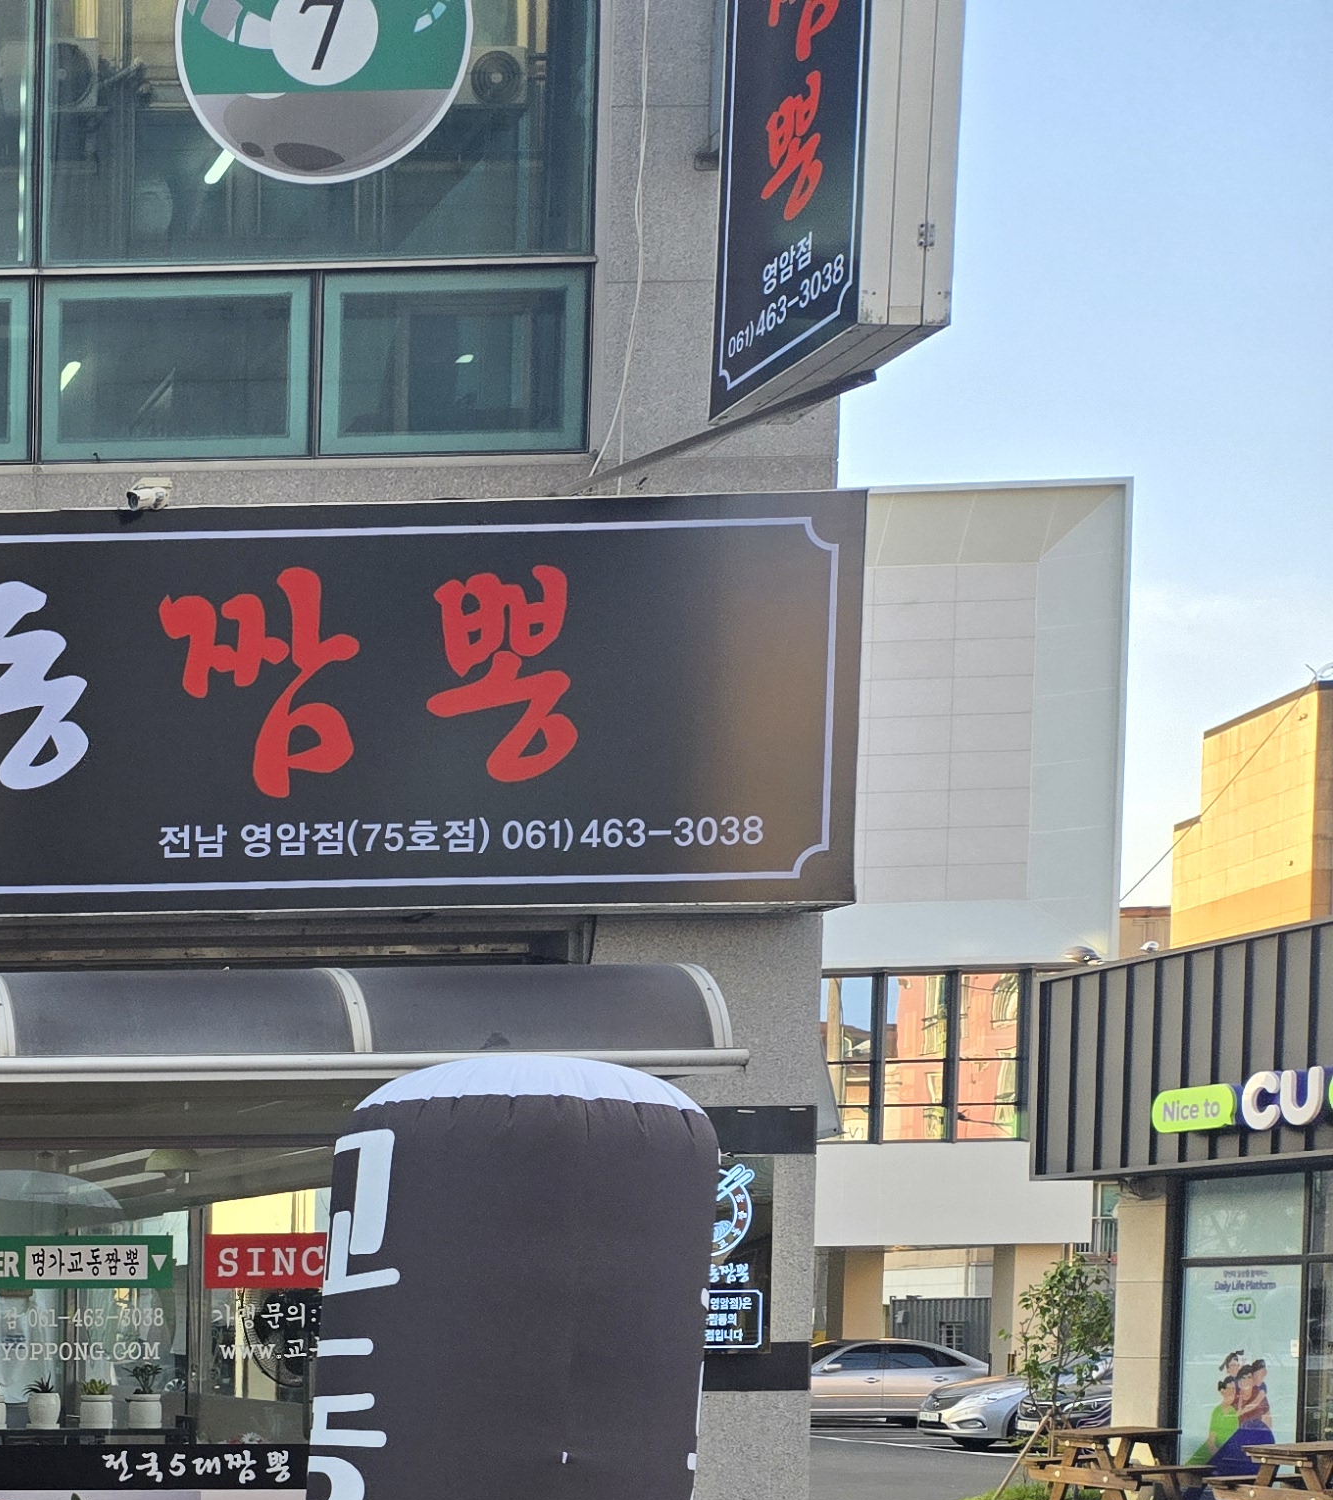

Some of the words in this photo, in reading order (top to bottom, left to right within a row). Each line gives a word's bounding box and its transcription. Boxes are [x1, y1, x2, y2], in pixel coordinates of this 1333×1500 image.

[298, 0, 345, 71] 7
[763, 231, 813, 295] 영암점
[728, 254, 845, 358] 061)463-3038
[159, 825, 229, 860] 전남
[241, 818, 491, 859] 영암점(75호점)
[503, 816, 765, 853] 061)463-3038
[1162, 1100, 1199, 1122] Nice
[1203, 1098, 1220, 1118] to
[1241, 1065, 1325, 1131] CU
[31, 1247, 141, 1277] 명가교동짬뽕
[217, 1246, 325, 1278] SINC
[27, 1307, 165, 1328] 061-463-3038
[1236, 1303, 1252, 1315] CU
